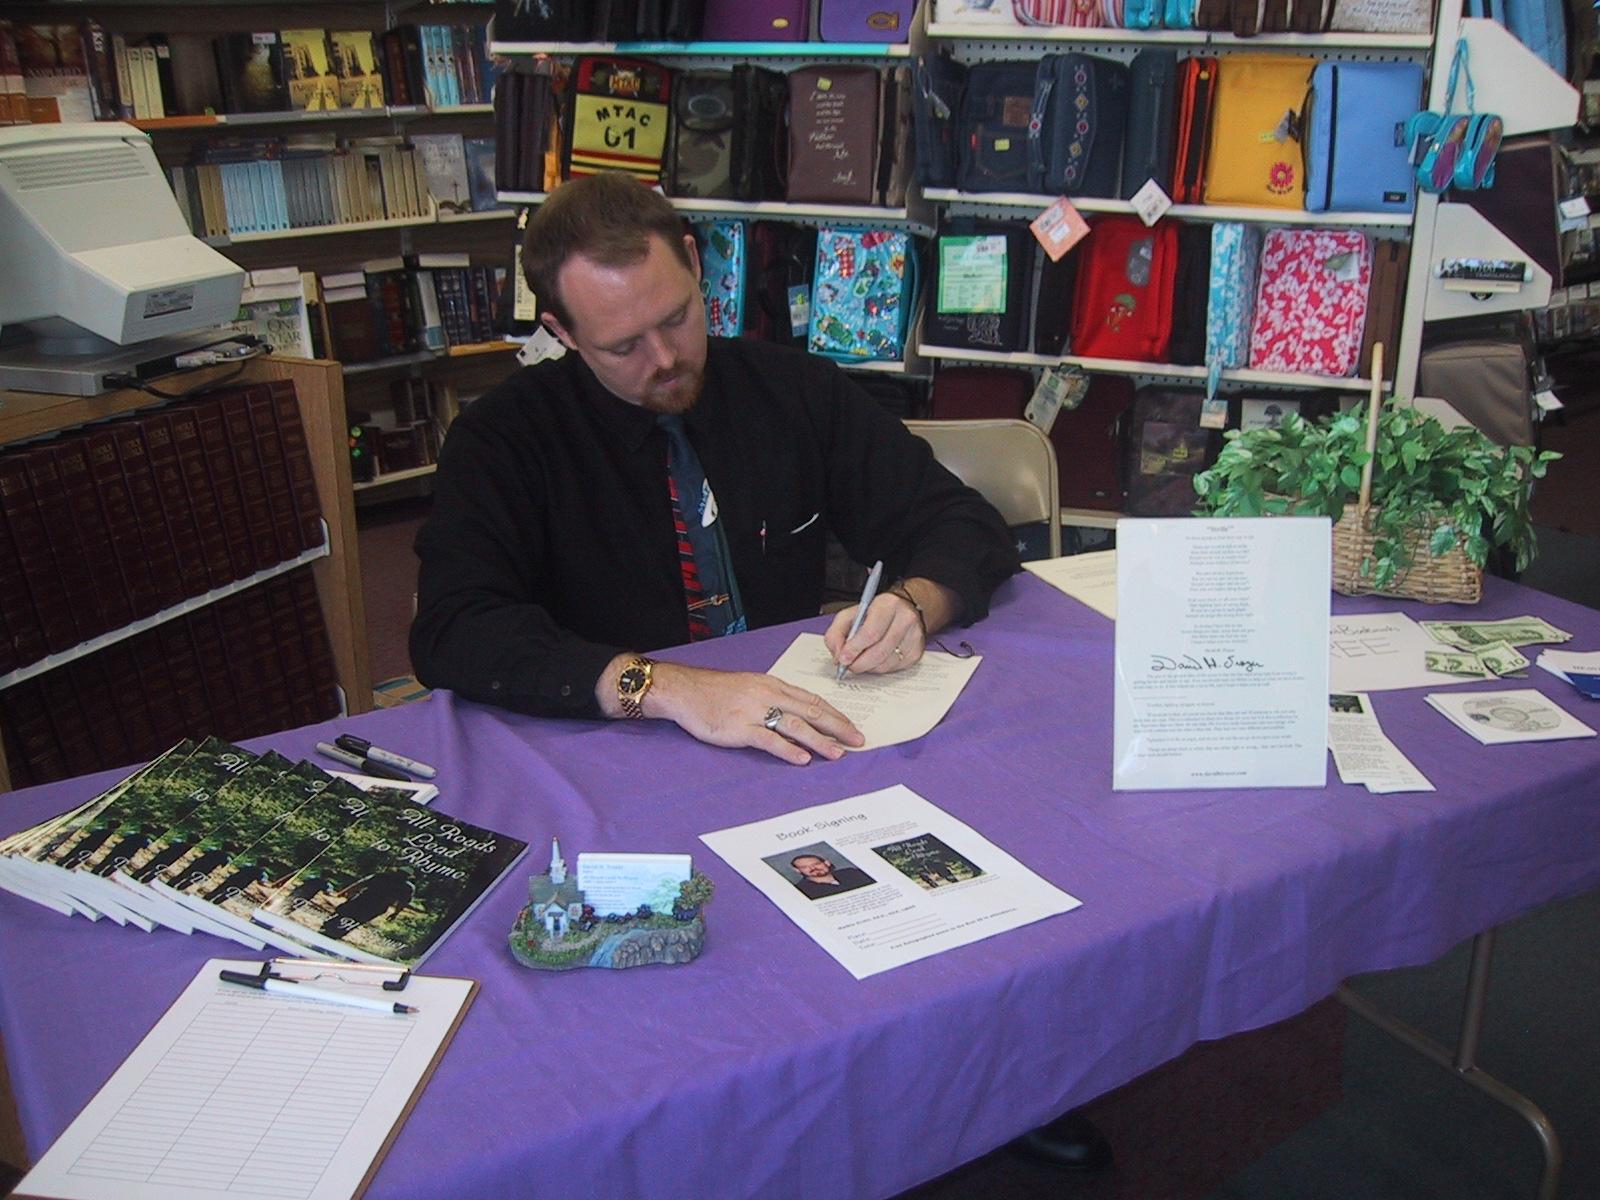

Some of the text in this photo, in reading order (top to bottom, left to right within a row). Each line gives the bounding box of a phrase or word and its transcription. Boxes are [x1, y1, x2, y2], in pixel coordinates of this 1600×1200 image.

[596, 104, 651, 127] MTAC
[396, 808, 497, 853] All Roads
[775, 813, 867, 841] Book Signing
[370, 838, 466, 880] to Rhyme
[402, 833, 466, 858] Lead
